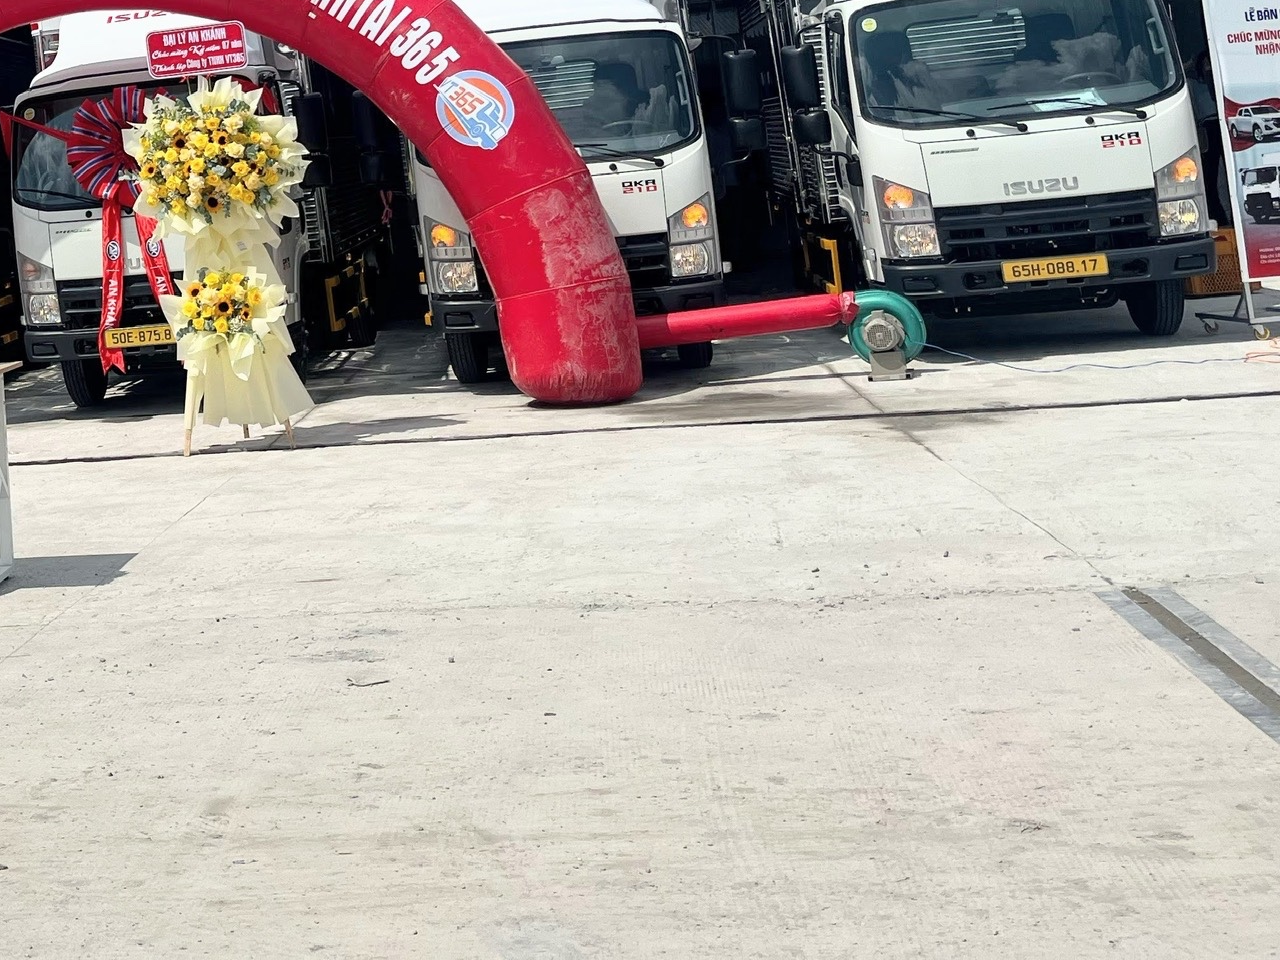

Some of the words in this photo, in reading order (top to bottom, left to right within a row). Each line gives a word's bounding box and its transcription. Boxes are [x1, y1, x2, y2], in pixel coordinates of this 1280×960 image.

[107, 10, 167, 24] ISUZ
[1244, 7, 1256, 22] LỄ
[162, 33, 176, 47] ĐẠI
[177, 31, 187, 45] LÝ
[188, 30, 200, 43] AN
[200, 26, 227, 41] KHÁNH
[1227, 31, 1253, 44] CHÚC
[390, 17, 460, 85] 365
[1100, 131, 1141, 142] QKR
[1102, 137, 1142, 148] 210
[621, 179, 656, 188] QKR
[623, 185, 657, 194] 210
[1002, 176, 1080, 196] ISUZU
[1011, 259, 1098, 278] 65H-088.17
[111, 328, 172, 345] 50E-875.8
